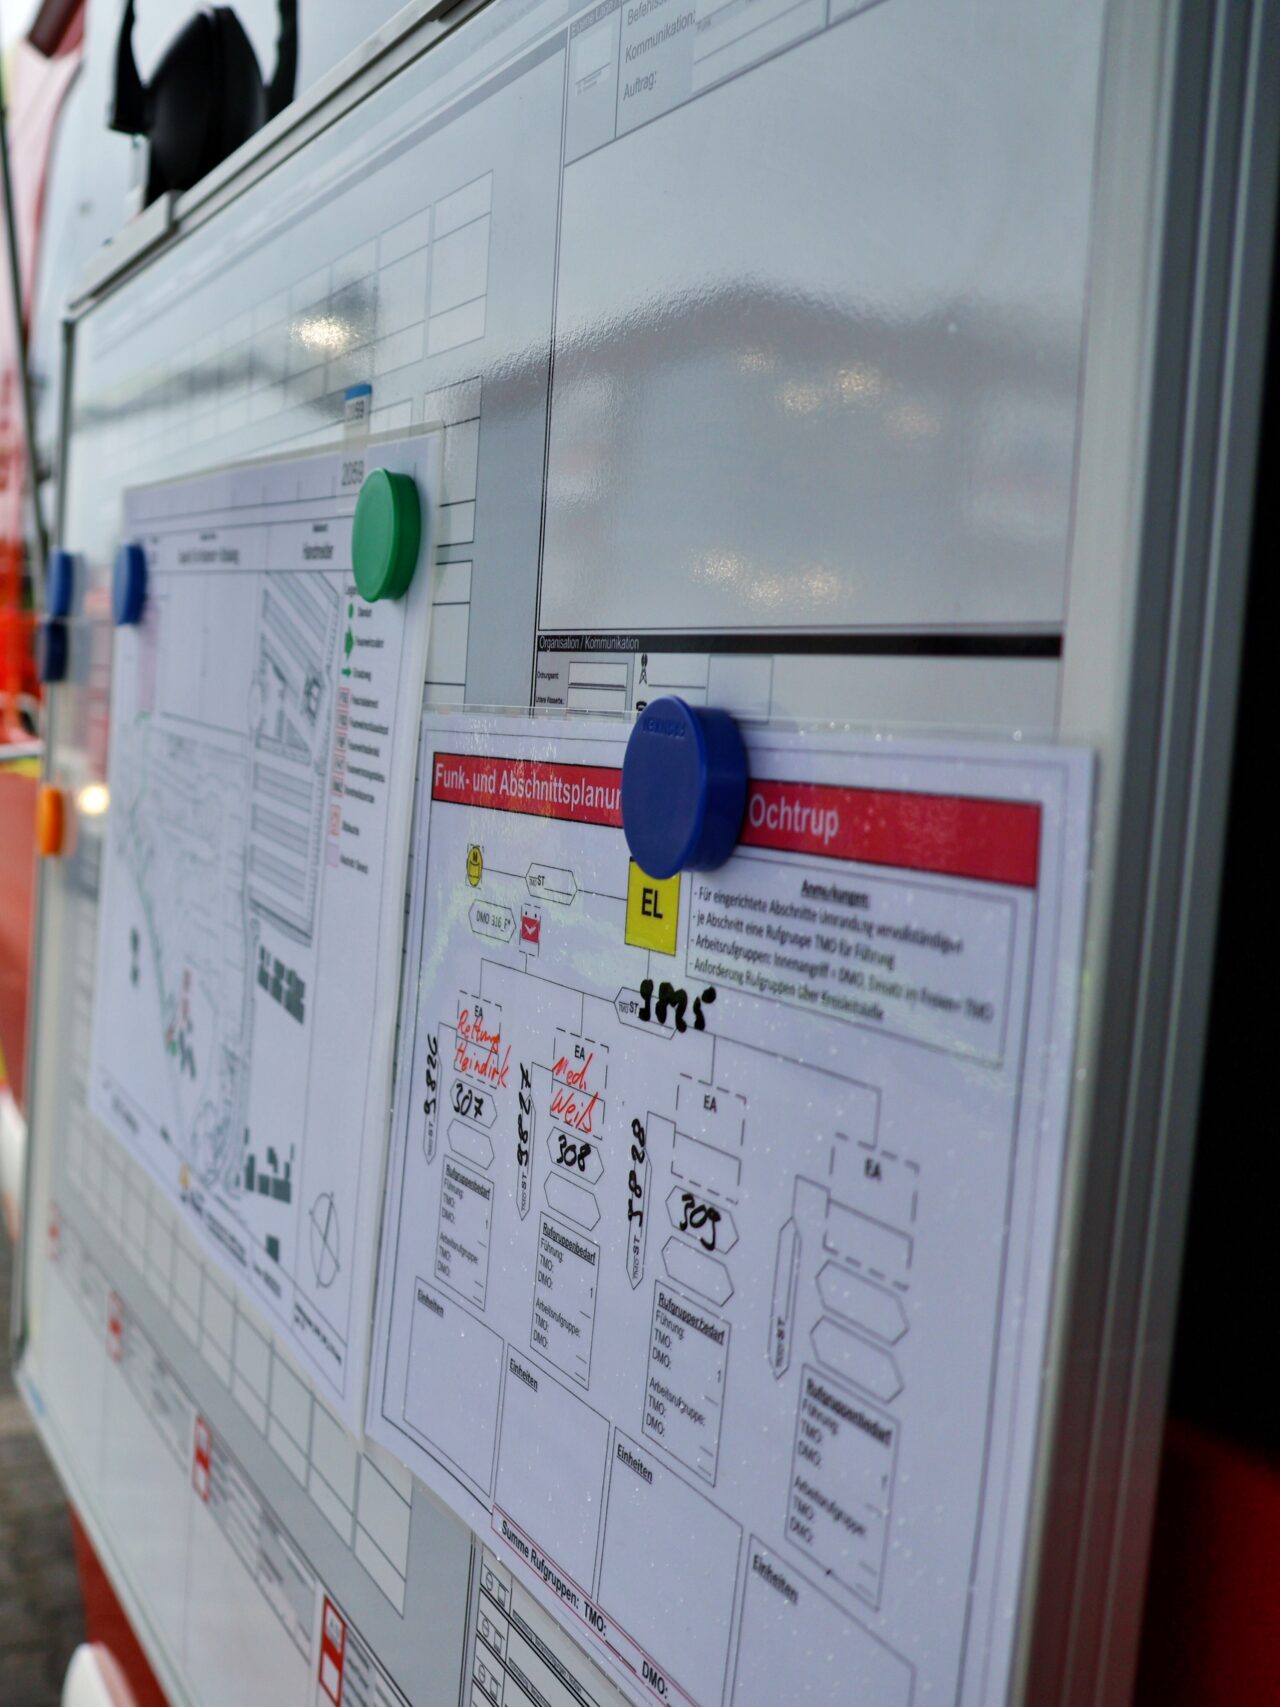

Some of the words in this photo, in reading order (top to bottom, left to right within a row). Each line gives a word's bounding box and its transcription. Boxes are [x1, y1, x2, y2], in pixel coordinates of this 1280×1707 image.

[625, 9, 696, 63] Kommunikation:
[623, 71, 657, 101] Auftrag:
[539, 635, 580, 653] Organisation
[585, 636, 640, 650] Kommunikation
[435, 762, 470, 791] Funk-
[473, 768, 497, 793] und
[748, 793, 840, 844] Ochtrup
[537, 874, 545, 887] ST
[476, 910, 490, 925] DMO
[641, 887, 664, 919] EL
[699, 886, 711, 900] Für
[714, 892, 768, 913] eingerichtete
[769, 899, 818, 923] Abschnitte
[696, 911, 705, 927] je
[706, 911, 744, 933] Abschnitt
[745, 921, 764, 938] eine
[766, 924, 812, 948] Rufgruppe
[815, 933, 837, 954] TMO
[694, 957, 744, 986] Anforderung
[746, 969, 796, 997] Rufgruppen
[474, 1004, 484, 1018] EA
[629, 1001, 639, 1014] ST
[575, 1045, 586, 1061] EA
[456, 1083, 484, 1119] 307
[704, 1094, 718, 1114] EA
[556, 1134, 592, 1172] 308
[864, 1158, 882, 1181] EA
[679, 1193, 722, 1251] 309
[540, 1238, 564, 1264] Führung:
[543, 1222, 596, 1266] Rufgruppenbedarf
[539, 1253, 554, 1273] TMO:
[537, 1271, 553, 1290] DMO:
[534, 1313, 549, 1332] TMO:
[535, 1297, 581, 1338] Arbeitsrufgruppe:
[656, 1309, 685, 1340] Führung:
[658, 1292, 725, 1346] Rufgruppenbedarf
[533, 1330, 548, 1349] DMO:
[654, 1328, 672, 1350] TMO:
[652, 1347, 671, 1370] DMO:
[509, 1358, 538, 1392] Einheiten
[648, 1395, 667, 1418] TMO:
[649, 1377, 705, 1426] Arbeitsrufgruppe:
[646, 1413, 665, 1437] DMO:
[616, 1444, 653, 1485] Einheiten
[752, 1553, 799, 1606] Einheiten
[501, 1519, 529, 1559] Summe
[530, 1548, 580, 1610] Rufgruppen:
[584, 1600, 608, 1637] TMO:
[641, 1660, 669, 1699] DMO:
